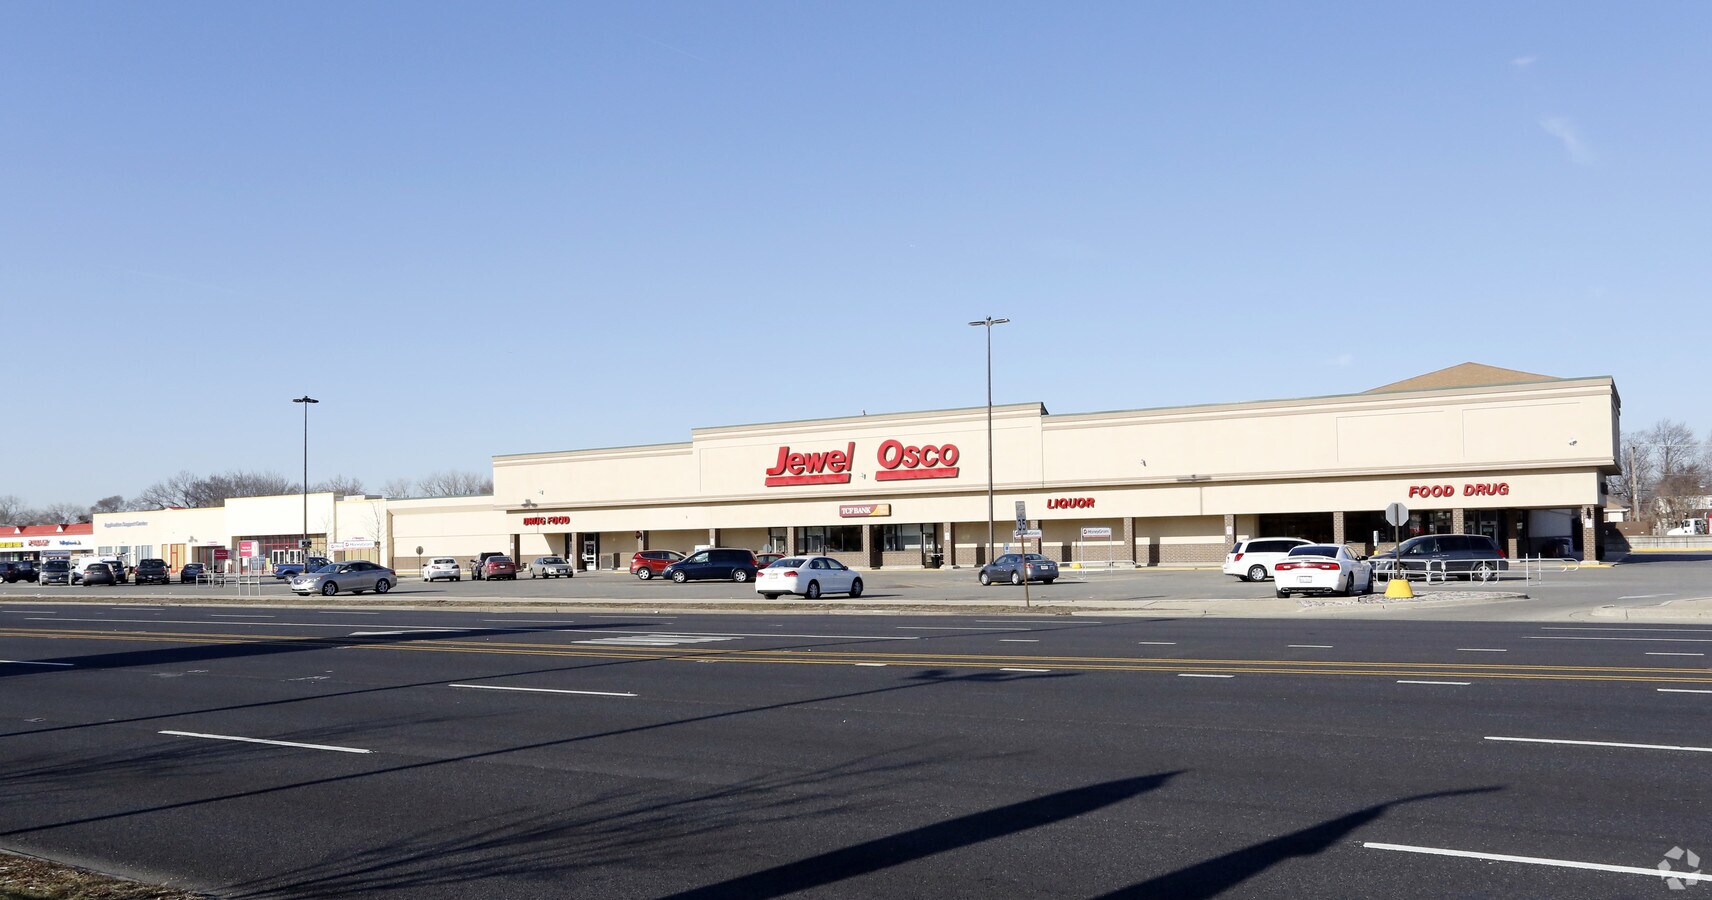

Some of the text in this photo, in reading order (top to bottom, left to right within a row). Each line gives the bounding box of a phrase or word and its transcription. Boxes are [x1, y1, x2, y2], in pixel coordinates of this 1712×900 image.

[765, 439, 960, 475] Jewel Osco
[1409, 482, 1509, 498] FOOD DRUG
[1047, 497, 1095, 509] LIQUOR
[841, 506, 871, 515] TCF BANK
[523, 516, 570, 525] DRUG FOOD
[1018, 519, 1026, 531] 35
